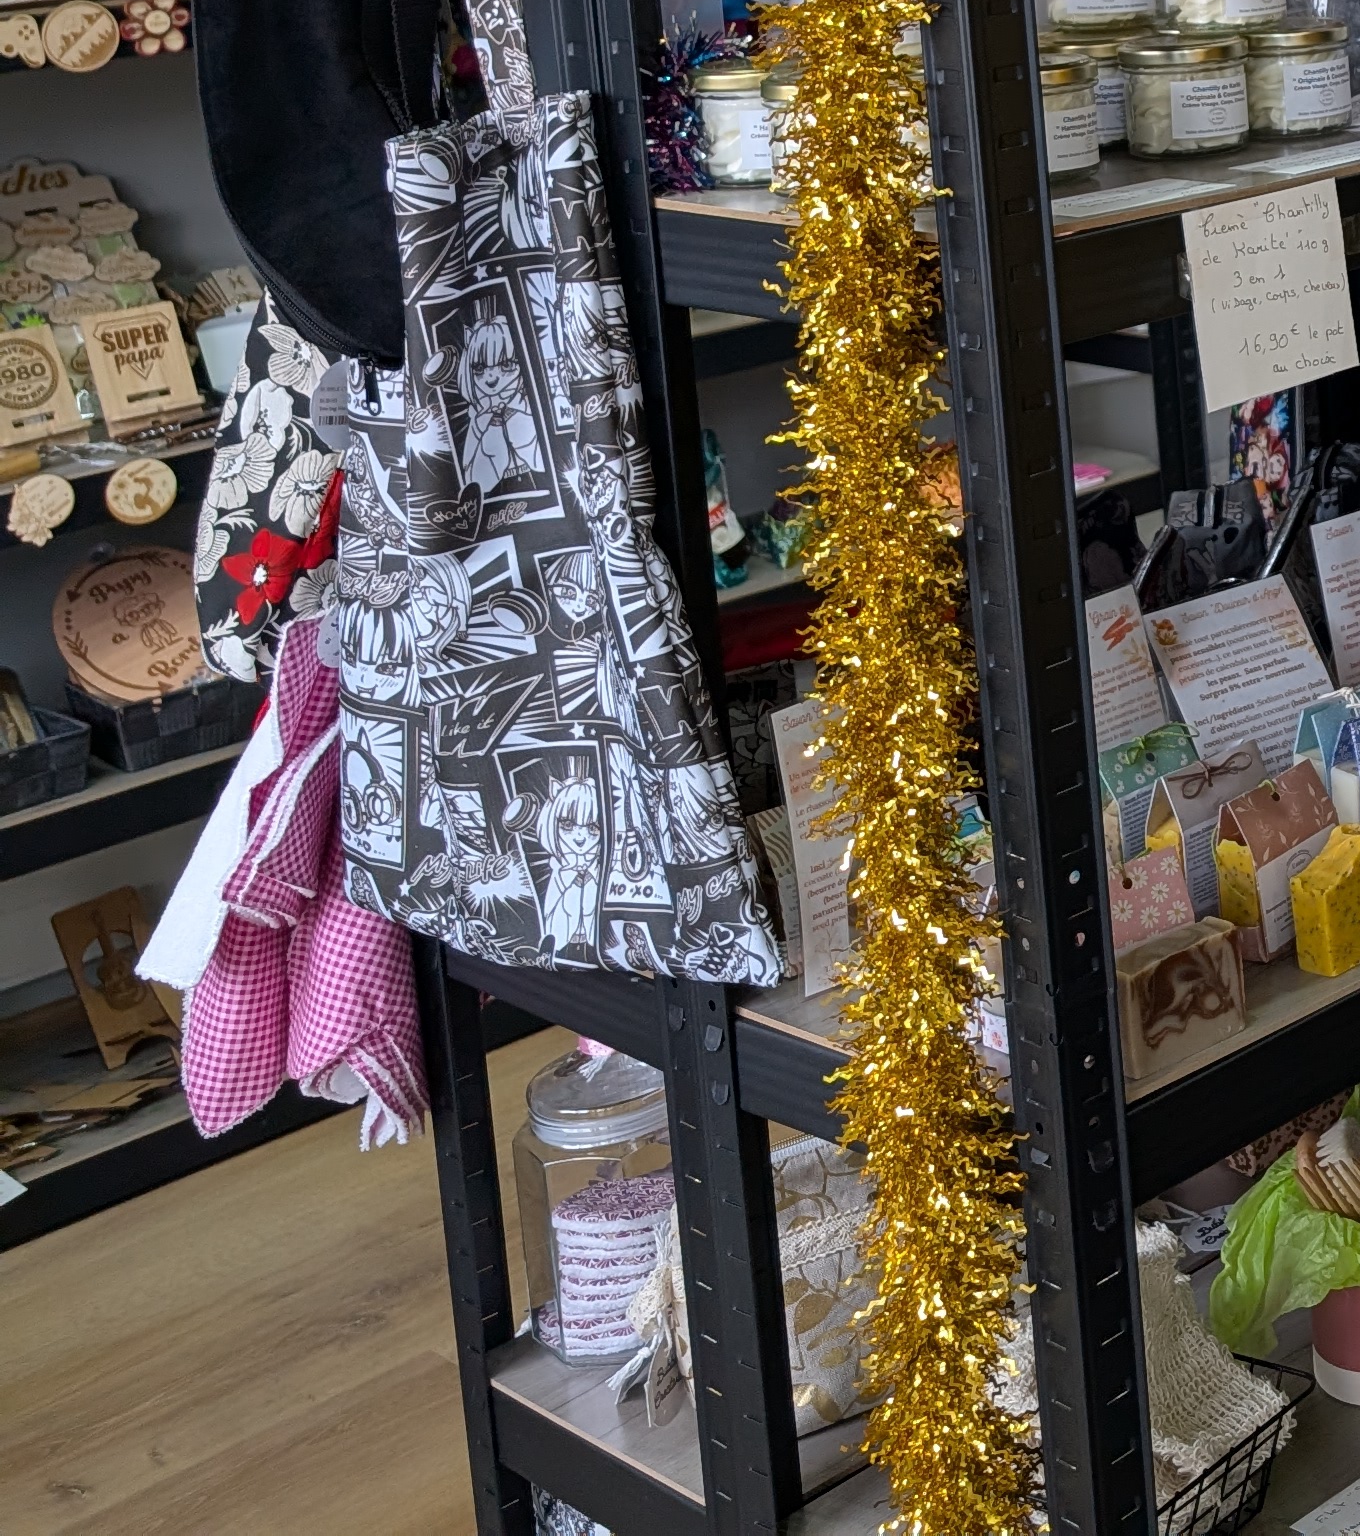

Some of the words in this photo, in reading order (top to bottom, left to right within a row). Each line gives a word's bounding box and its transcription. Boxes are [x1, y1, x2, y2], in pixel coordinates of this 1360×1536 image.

[1202, 251, 1221, 266] de
[1234, 271, 1242, 288] 3
[1250, 275, 1265, 284] en
[1274, 264, 1285, 279] 1
[101, 323, 169, 353] SUPER
[1308, 326, 1318, 339] le
[1326, 321, 1344, 341] pot
[114, 347, 164, 375] papa
[1273, 364, 1288, 373] au
[1296, 352, 1337, 369] choix
